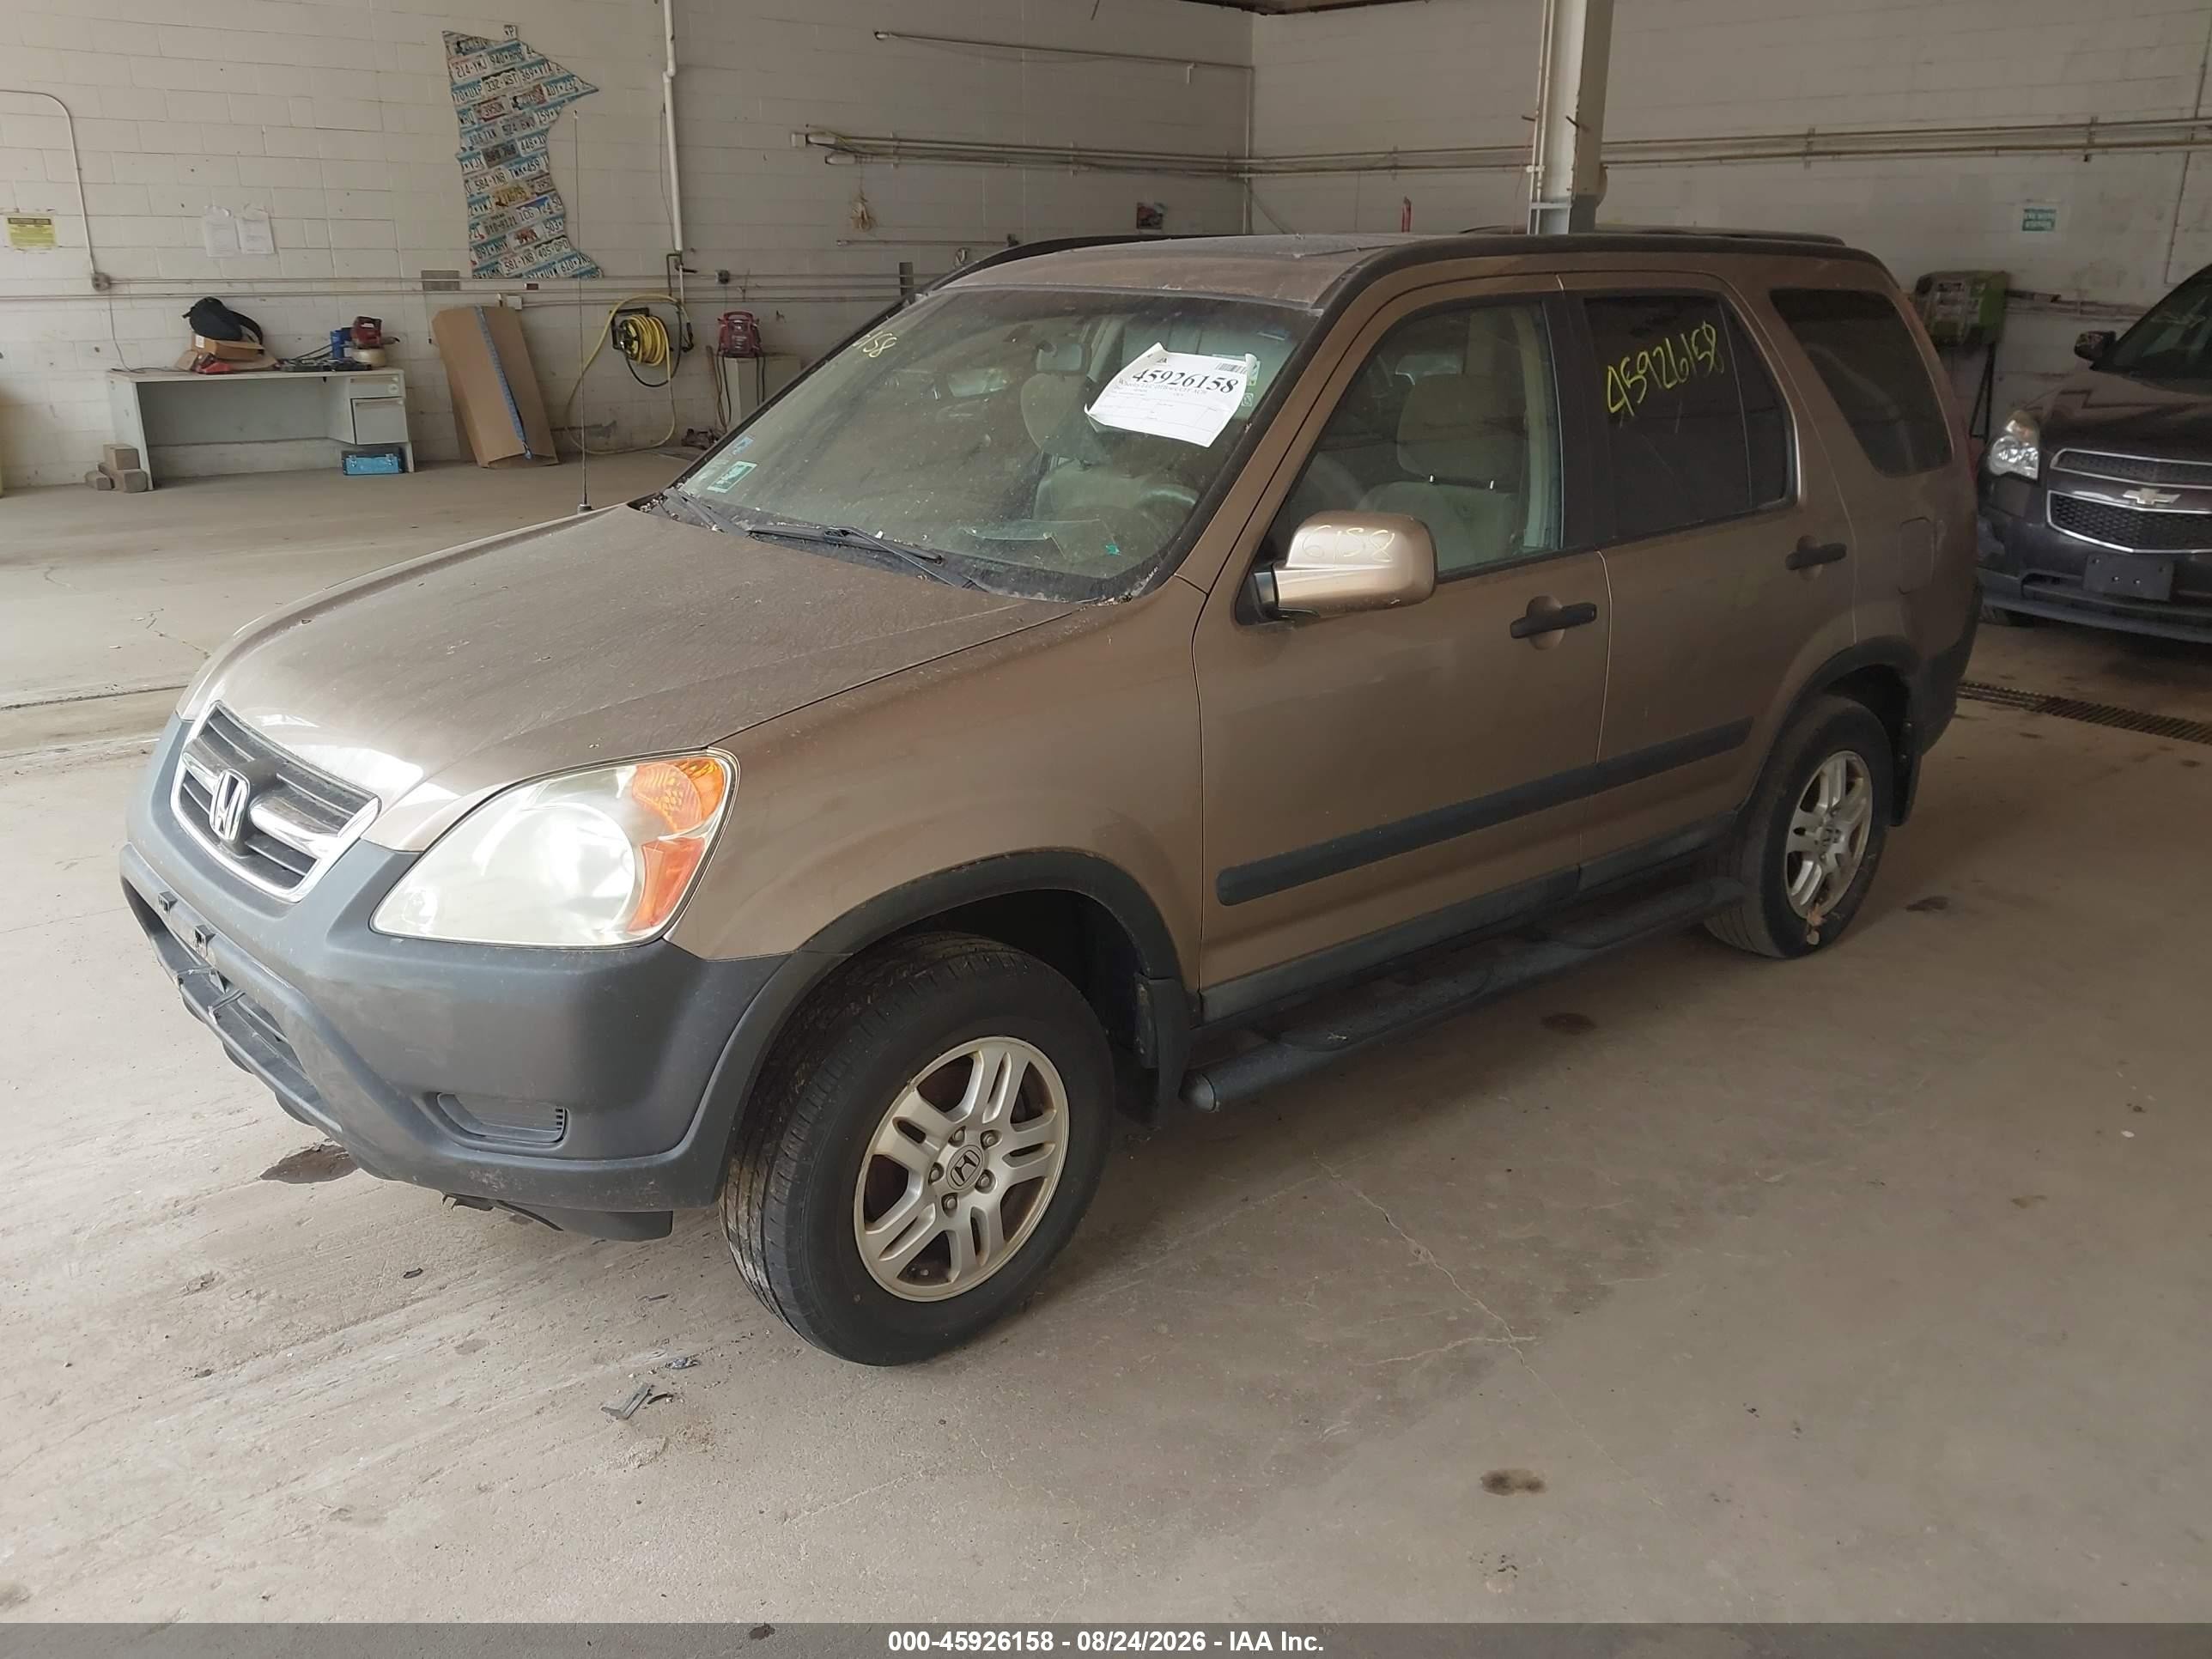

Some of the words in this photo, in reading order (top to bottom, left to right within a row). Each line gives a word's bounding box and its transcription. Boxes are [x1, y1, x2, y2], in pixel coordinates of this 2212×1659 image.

[1132, 368, 1239, 393] 45926158
[1607, 321, 1724, 416] 45926158
[1302, 525, 1395, 563] 6158
